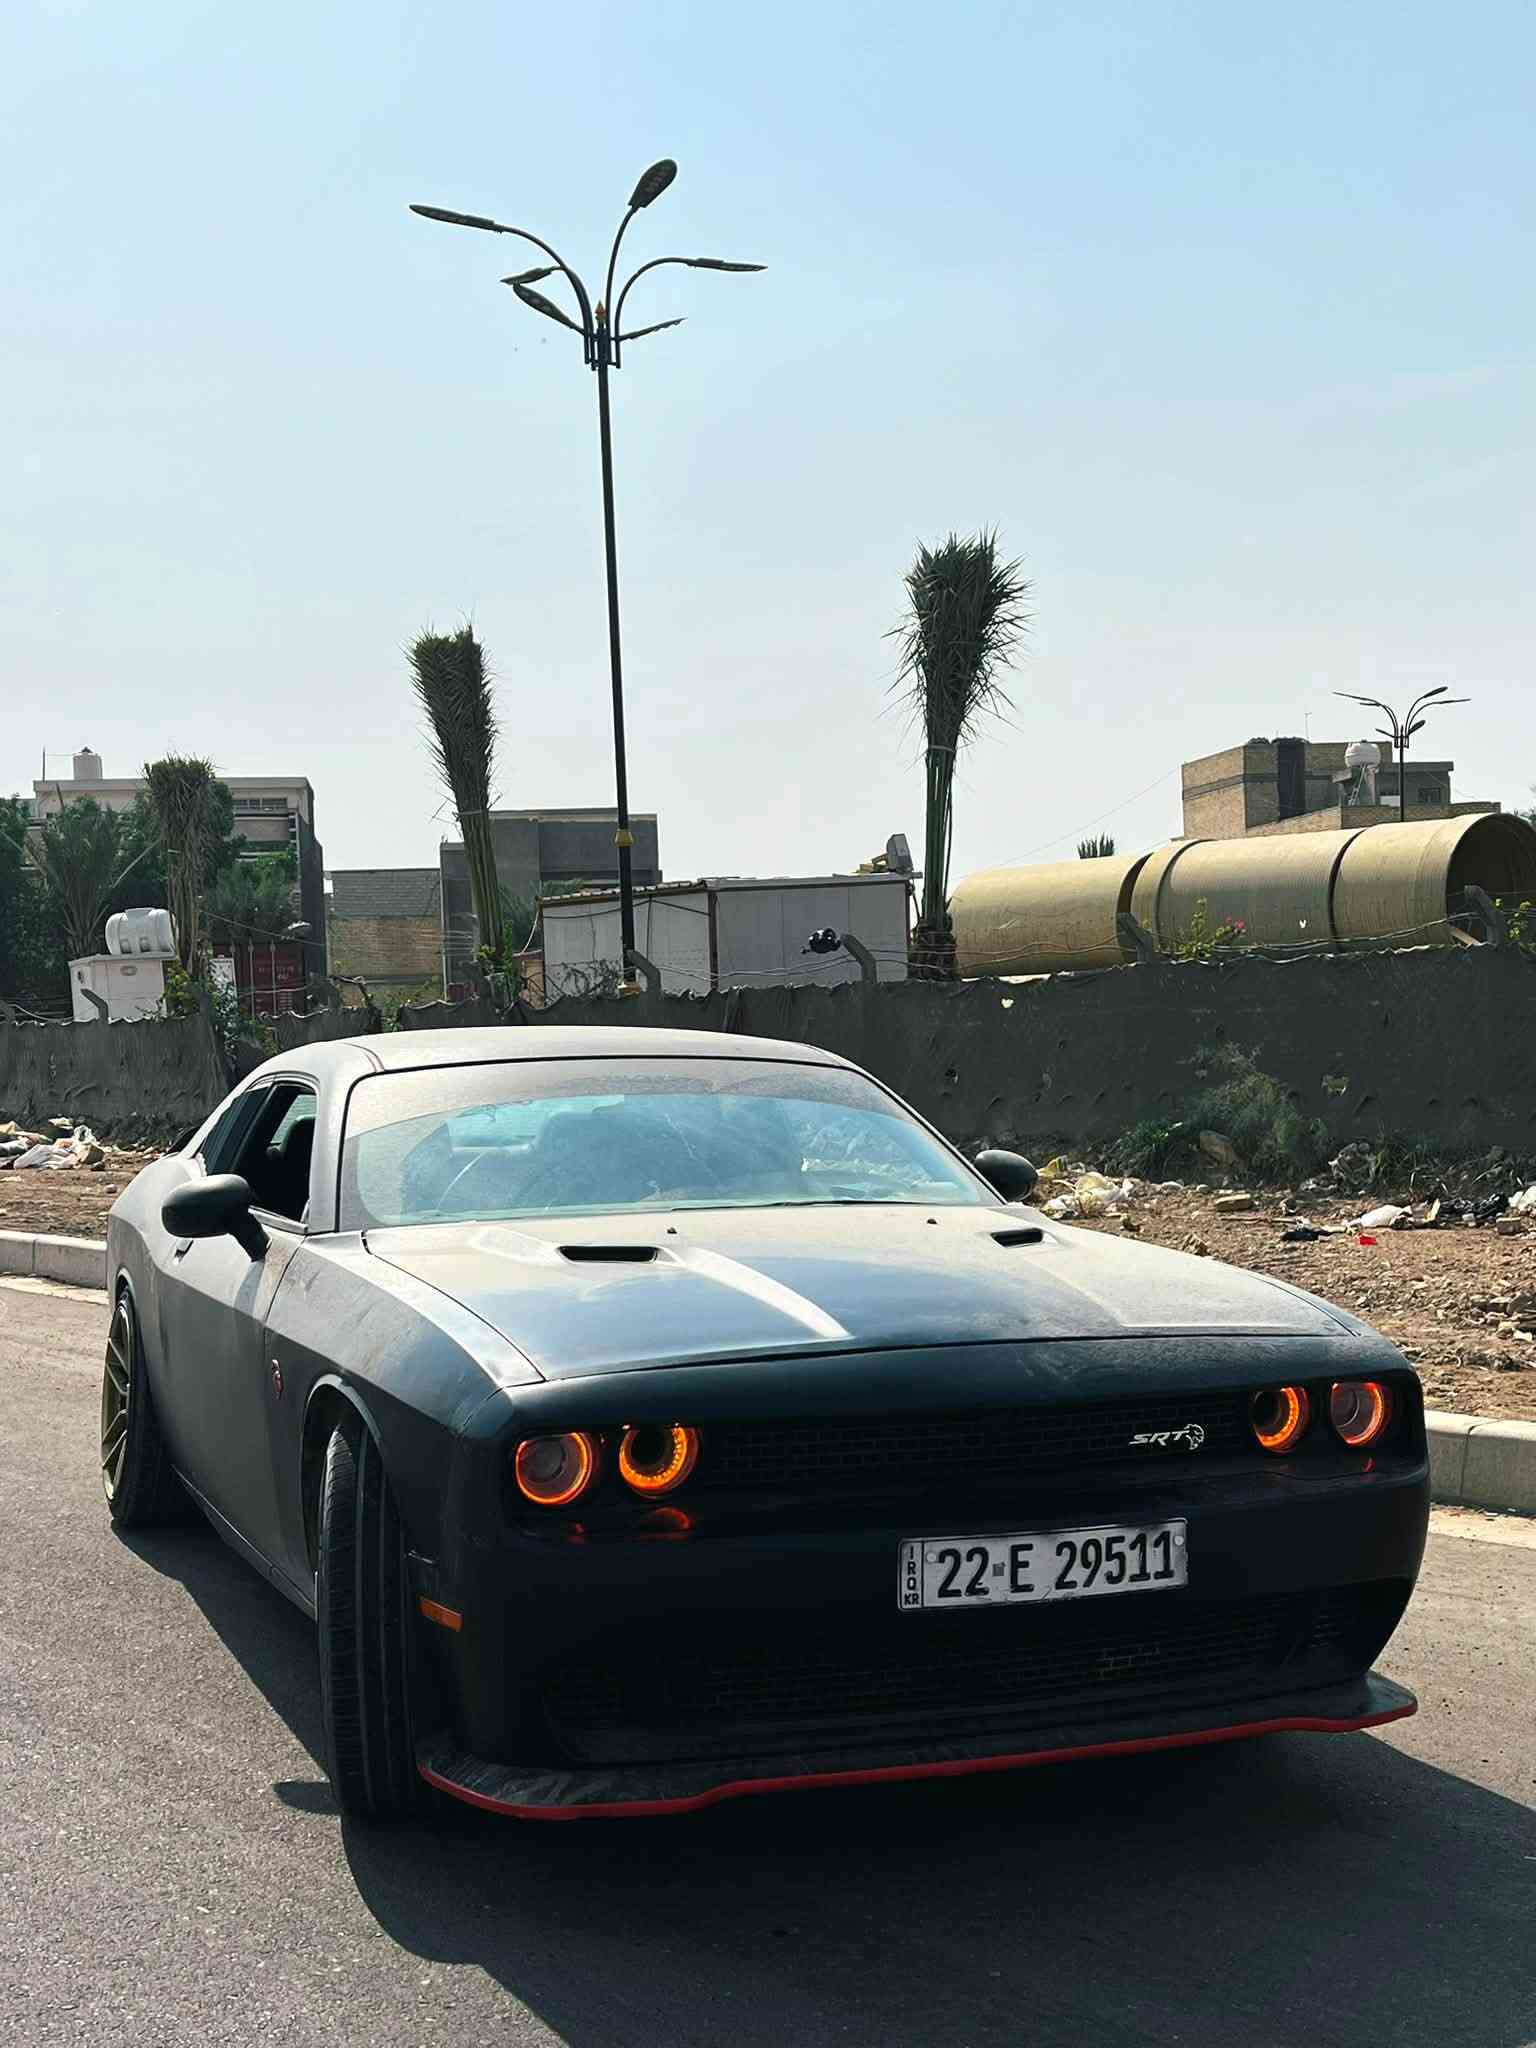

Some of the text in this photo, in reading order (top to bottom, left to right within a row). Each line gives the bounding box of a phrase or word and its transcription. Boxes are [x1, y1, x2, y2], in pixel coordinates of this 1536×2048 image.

[1128, 1430, 1190, 1446] SRT
[937, 1530, 1174, 1598] 22 E 29511
